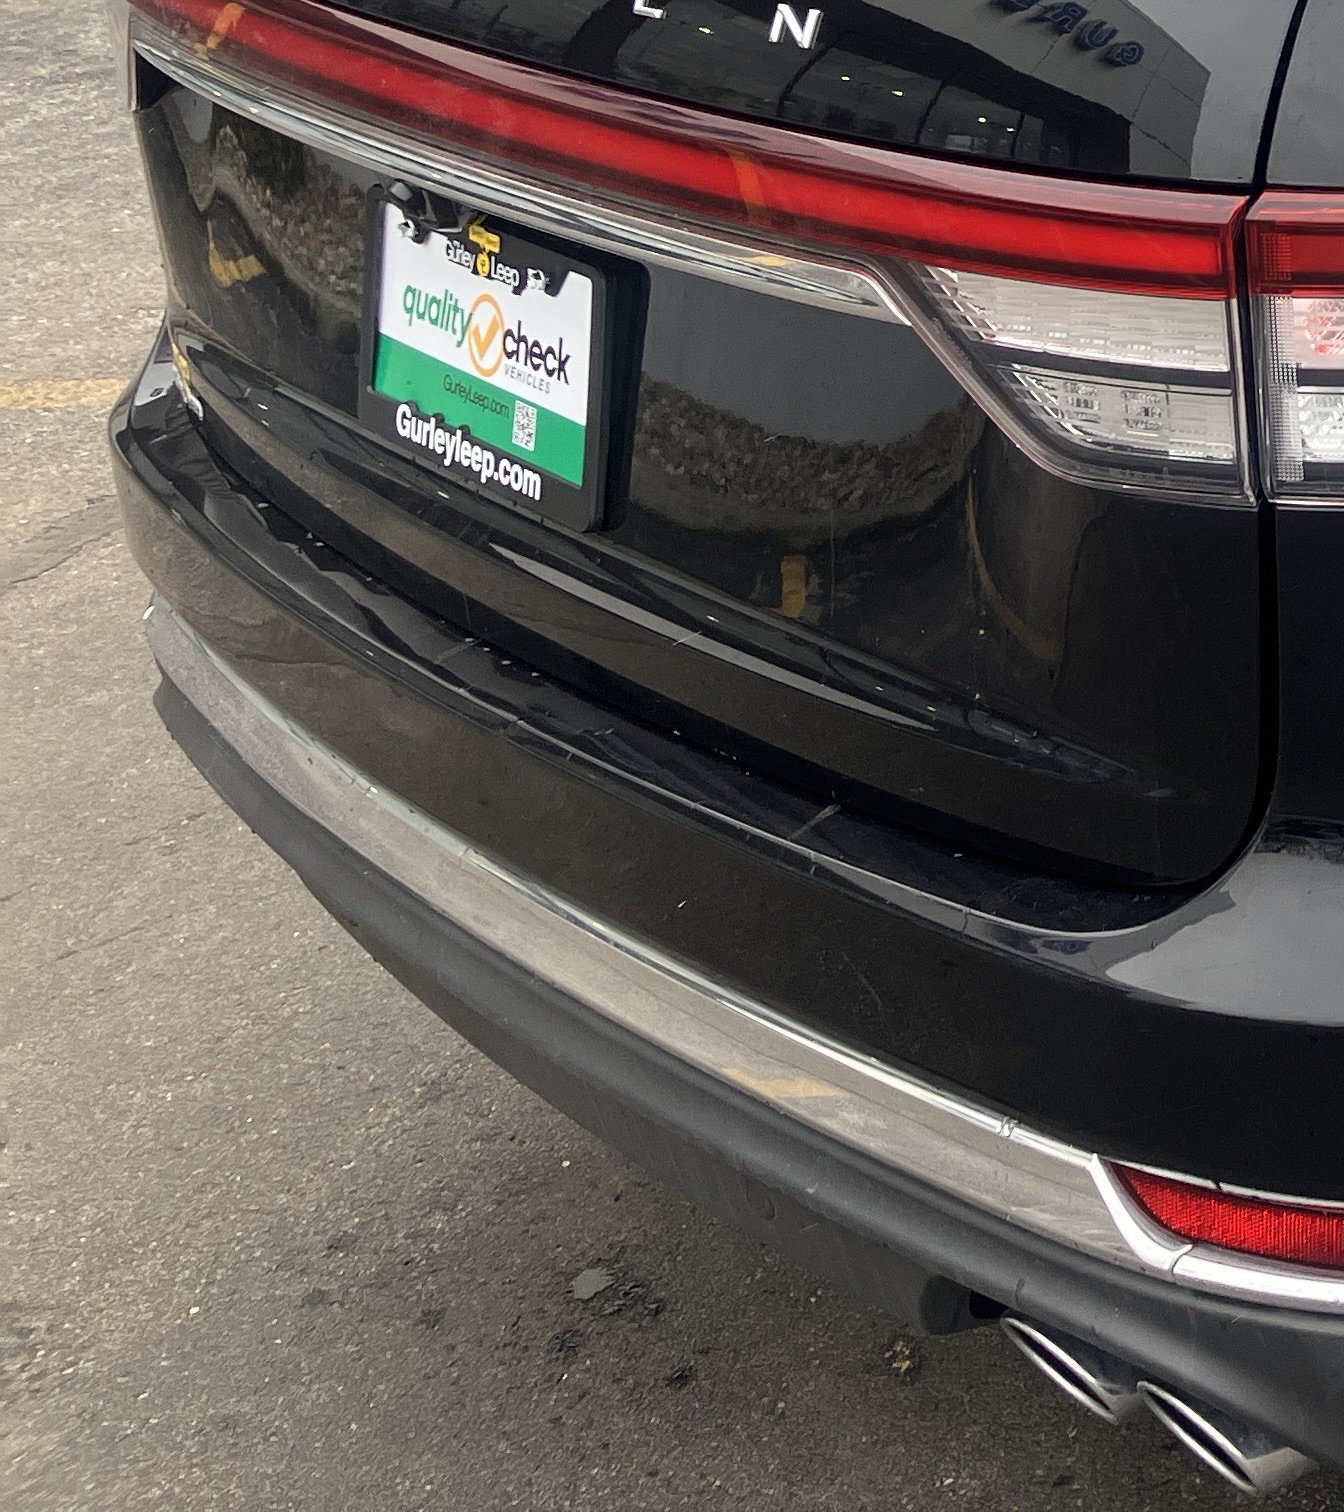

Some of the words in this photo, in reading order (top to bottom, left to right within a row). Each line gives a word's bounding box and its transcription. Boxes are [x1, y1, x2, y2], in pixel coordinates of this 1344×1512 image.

[403, 284, 472, 348] quality
[503, 321, 571, 385] check
[503, 364, 552, 395] VEHICLES
[395, 403, 542, 501] Gurleyleep.com
